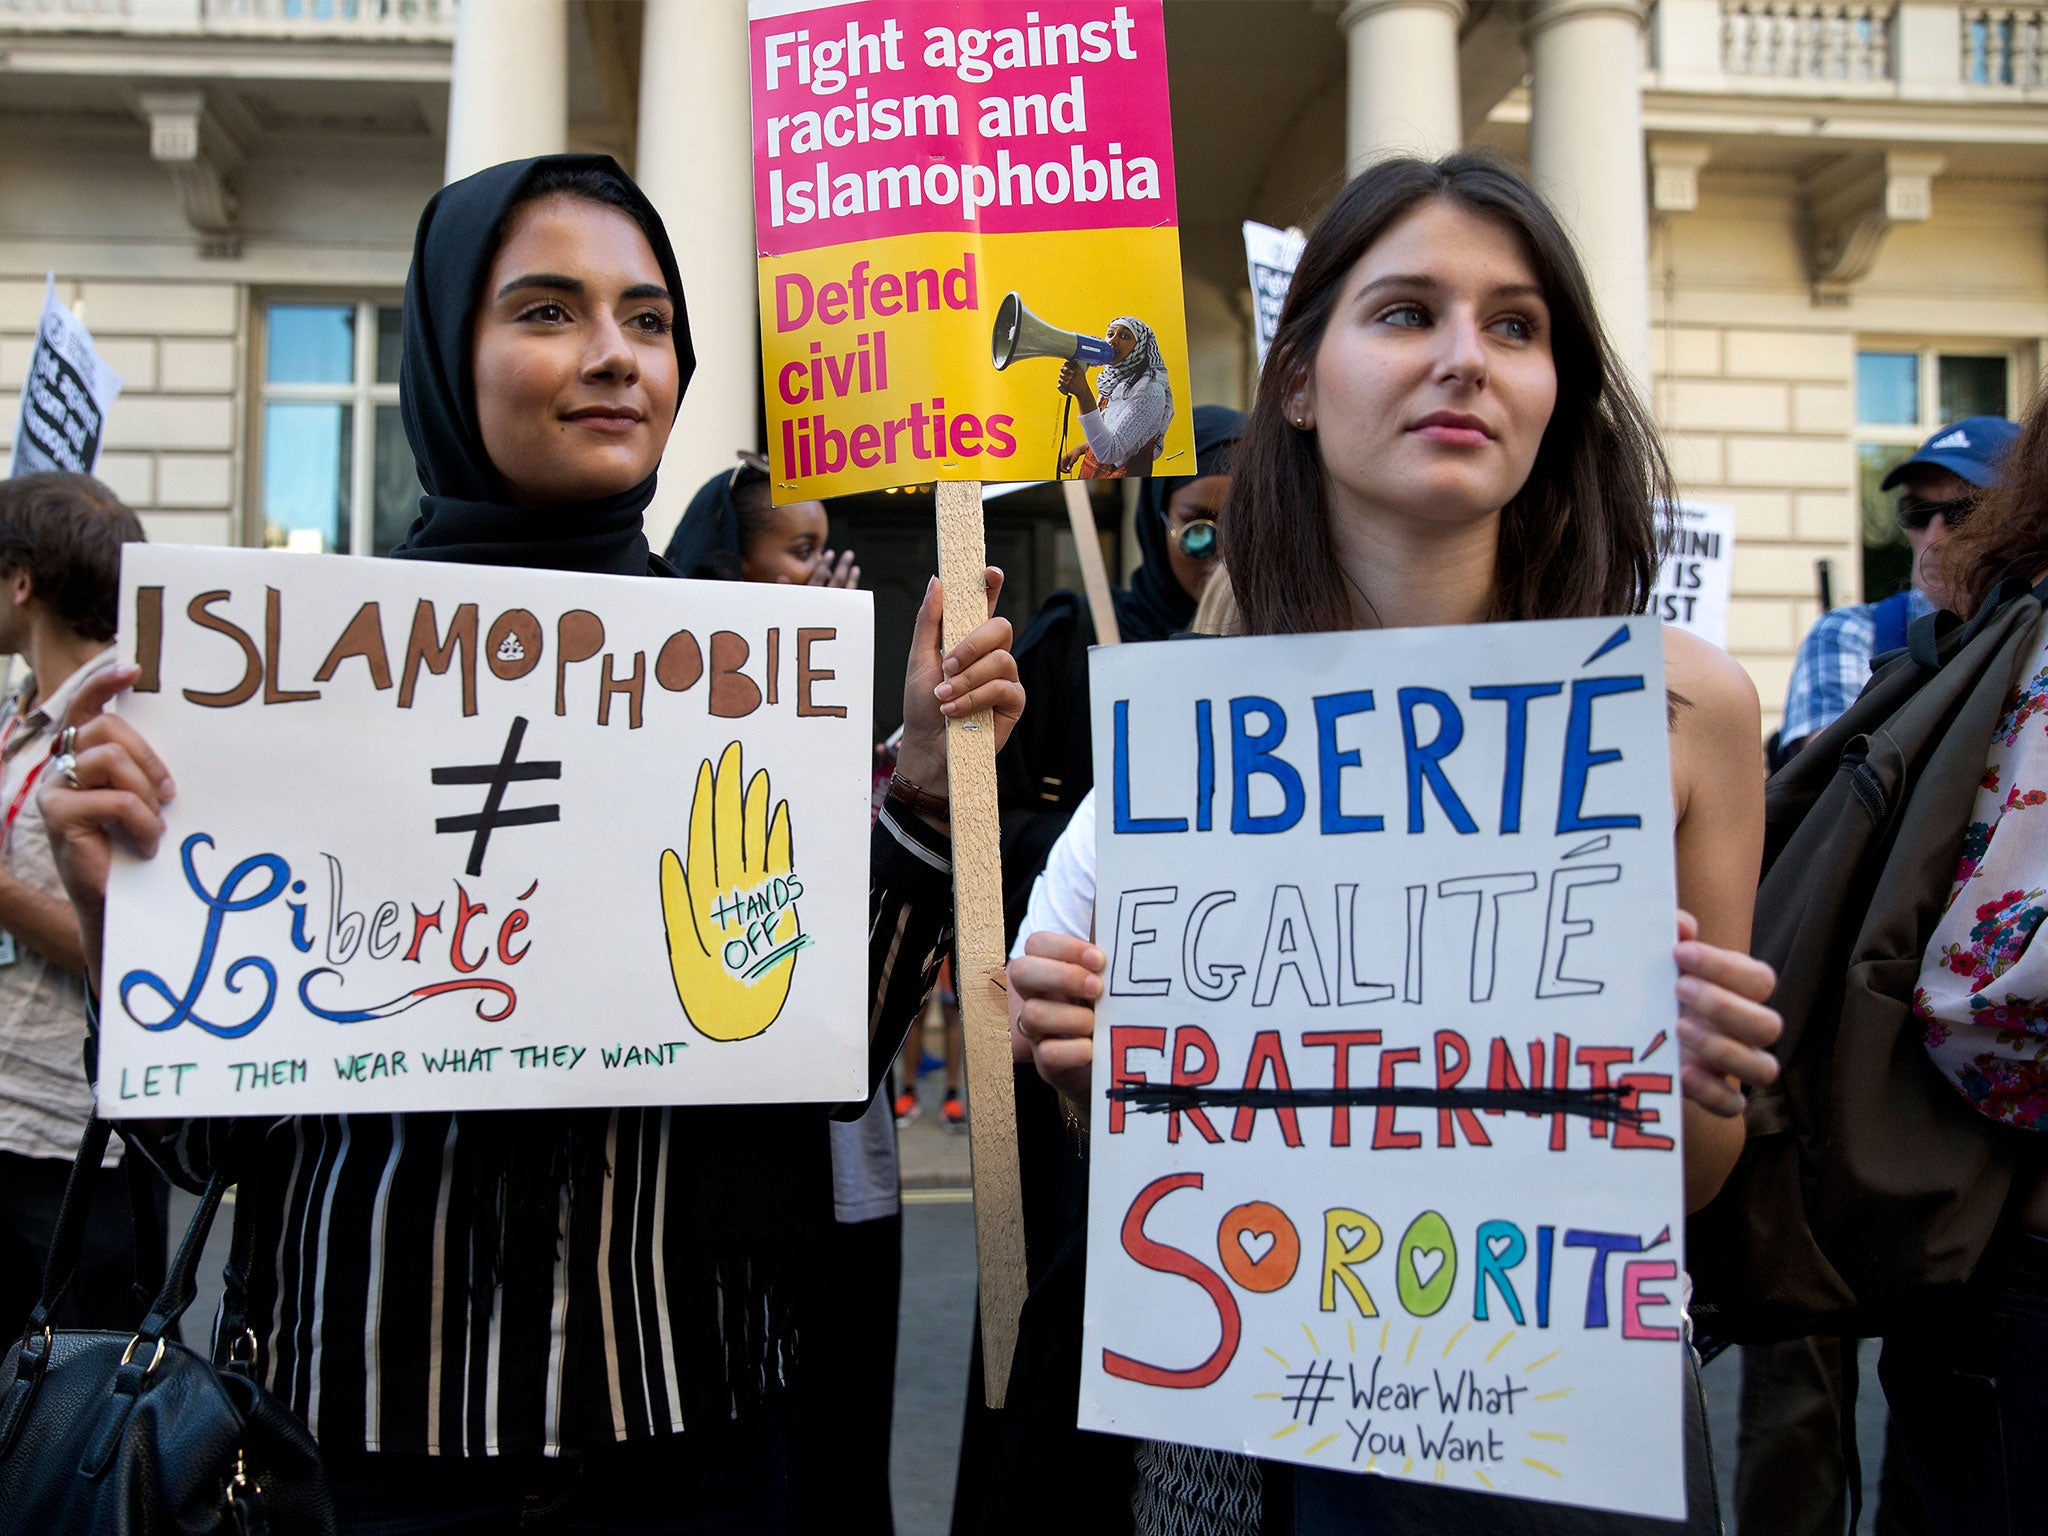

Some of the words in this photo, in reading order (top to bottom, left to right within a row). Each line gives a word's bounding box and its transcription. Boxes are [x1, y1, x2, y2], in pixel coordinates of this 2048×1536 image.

[764, 18, 905, 96] Fight
[923, 6, 1137, 84] against
[767, 87, 959, 158] racism
[977, 75, 1088, 139] and
[769, 142, 1161, 228] Islamophobia
[774, 252, 979, 334] Defend
[778, 330, 888, 406] civil
[781, 397, 1017, 481] liberties
[1675, 562, 1702, 589] IS
[132, 585, 848, 730] ISLAMOPHOBIE
[1113, 624, 1646, 836] LIBERTÉ
[120, 832, 539, 1039] Liberté
[710, 874, 804, 931] HANDS
[724, 911, 780, 970] OFF
[1109, 834, 1621, 1007] EGALITÉ
[120, 1063, 198, 1101] LET
[228, 1058, 308, 1092] THEM
[334, 1050, 409, 1082] WEAR
[422, 1046, 503, 1075] WHAT
[511, 1045, 587, 1070] THEY
[601, 1041, 689, 1069] WANT
[1108, 1025, 1675, 1150] FRATERNITÉ
[1102, 1172, 1680, 1389] SORORITÉ
[1345, 1418, 1406, 1462] You
[1417, 1420, 1504, 1462] Want
